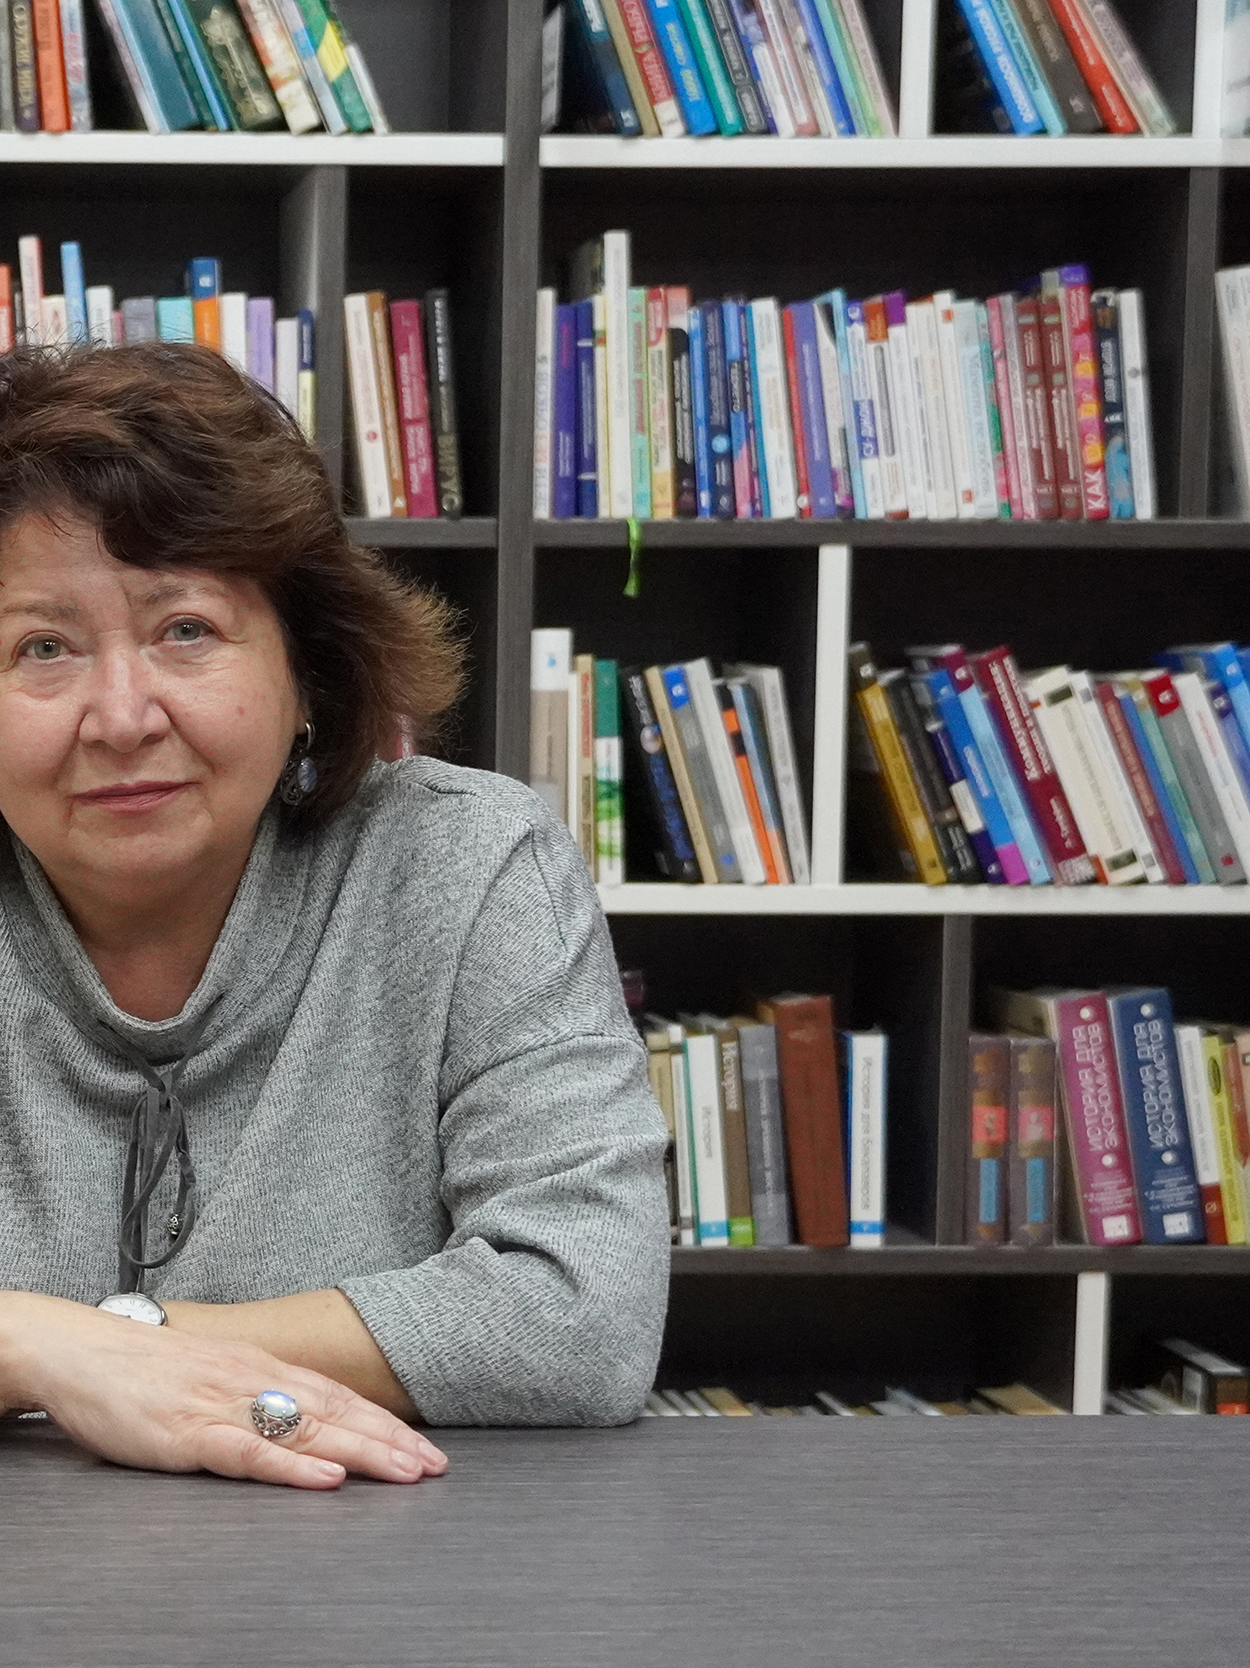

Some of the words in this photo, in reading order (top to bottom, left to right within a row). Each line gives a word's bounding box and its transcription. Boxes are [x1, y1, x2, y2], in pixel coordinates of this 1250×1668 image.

[436, 433, 461, 511] ВИРУС
[1085, 469, 1106, 510] КАК
[1071, 1025, 1091, 1064] ДЛЯ
[1133, 1020, 1149, 1059] ДЛЯ
[720, 1040, 738, 1112] История
[860, 1056, 872, 1109] История
[1078, 1067, 1102, 1151] ИСТОРИЯ
[1086, 1022, 1118, 1148] ЭКОНОМИСТОВ
[1139, 1064, 1162, 1148] ИСТОРИЯ
[1148, 1019, 1179, 1146] ЭКОНОМИСТОВ
[701, 1104, 713, 1159] История
[861, 1137, 871, 1210] бакалавров
